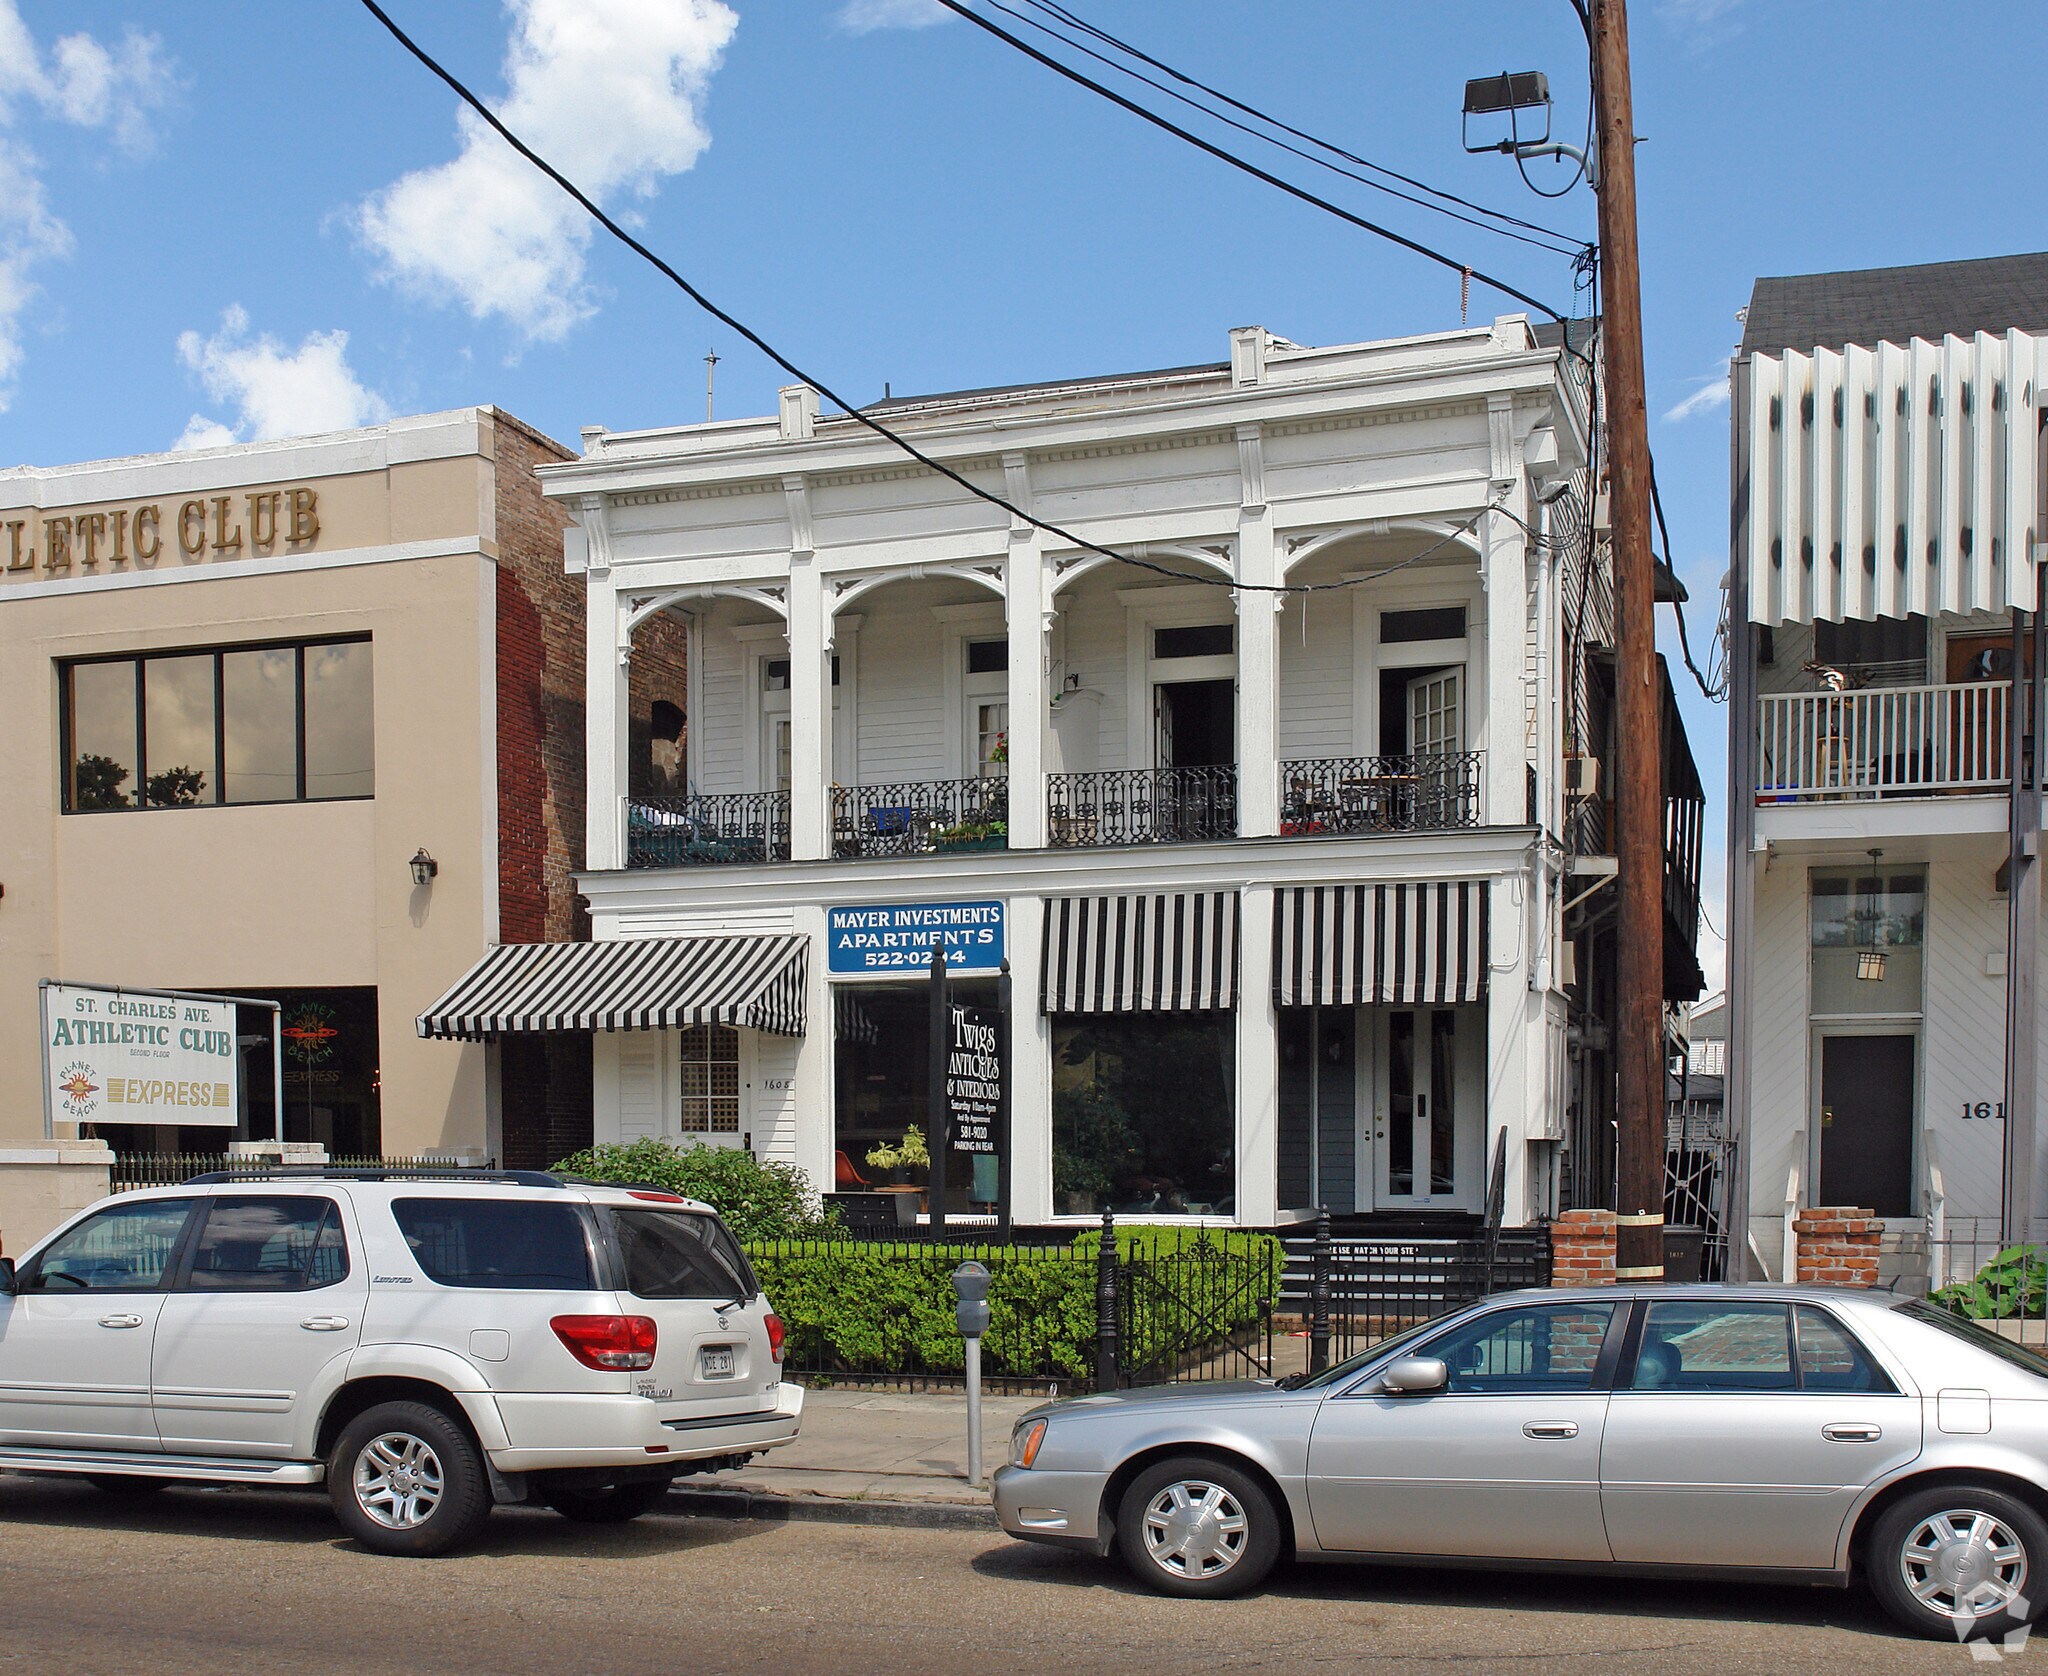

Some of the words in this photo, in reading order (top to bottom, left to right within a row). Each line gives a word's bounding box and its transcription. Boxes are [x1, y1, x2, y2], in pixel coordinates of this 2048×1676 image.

[0, 504, 161, 571] LETIC
[177, 486, 320, 553] CLUB
[833, 911, 890, 929] MAYER
[895, 906, 1000, 926] INVESTMENTS
[838, 928, 994, 949] APARTMENTS
[75, 997, 98, 1013] ST.
[108, 1000, 176, 1020] CHARLES
[184, 1007, 212, 1023] AVE.
[286, 1002, 336, 1022] PLANET
[52, 1018, 170, 1047] ATHLETIC
[180, 1028, 232, 1057] CLUB
[952, 1008, 996, 1065] Twigs
[130, 1048, 151, 1057] SECOND
[153, 1050, 171, 1058] FLOOR
[287, 1045, 333, 1064] BEACH
[59, 1060, 97, 1080] PLANET
[293, 1070, 341, 1083] EXPRESS
[948, 1052, 1000, 1081] ANTIQUES
[126, 1079, 212, 1107] EXPRESS
[764, 1079, 791, 1090] 1608
[946, 1078, 955, 1096] &
[956, 1080, 1001, 1101] INTERIORS
[62, 1100, 97, 1118] BEACH
[951, 1099, 971, 1114] Saturday
[960, 1125, 988, 1139] 581-9020
[953, 1140, 975, 1151] PARKING
[975, 1141, 982, 1151] IN
[982, 1141, 994, 1152] REAR
